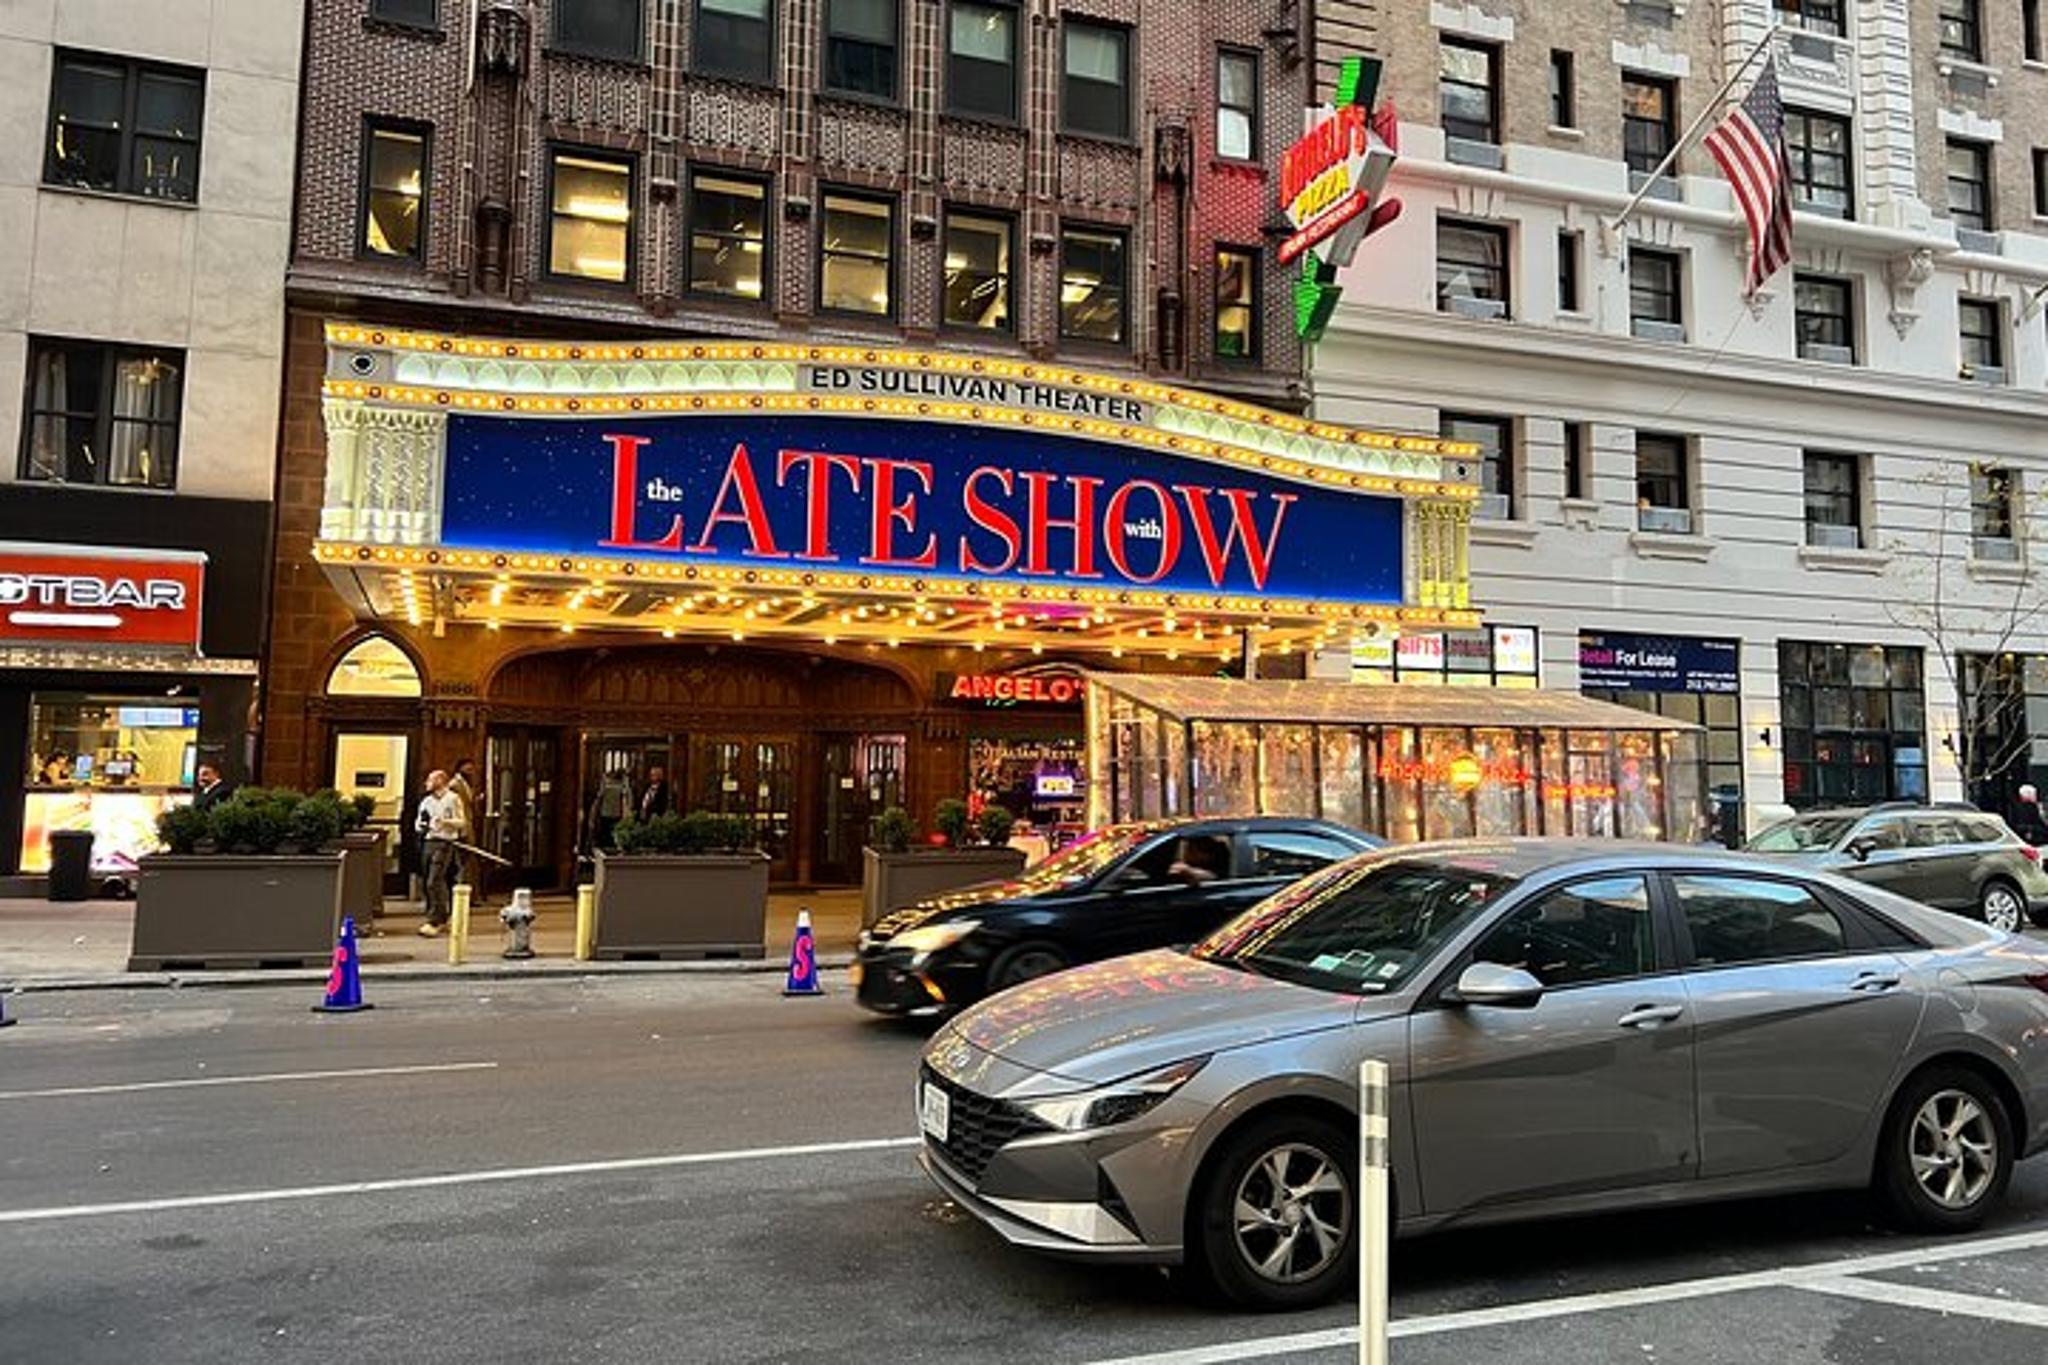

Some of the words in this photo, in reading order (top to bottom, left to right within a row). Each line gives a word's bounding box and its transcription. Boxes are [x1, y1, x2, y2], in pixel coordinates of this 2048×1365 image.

[1294, 163, 1350, 224] PIZZA
[811, 367, 851, 389] ED
[861, 371, 1006, 402] SULLIVAN
[1015, 386, 1143, 422] THEATER
[647, 478, 683, 501] the
[597, 433, 938, 568] LATE
[958, 465, 1299, 590] SHOW
[1124, 518, 1162, 540] with
[1615, 649, 1637, 667] For
[1639, 651, 1677, 669] Lease
[951, 675, 1086, 702] ANGELO'
[793, 935, 811, 981] S
